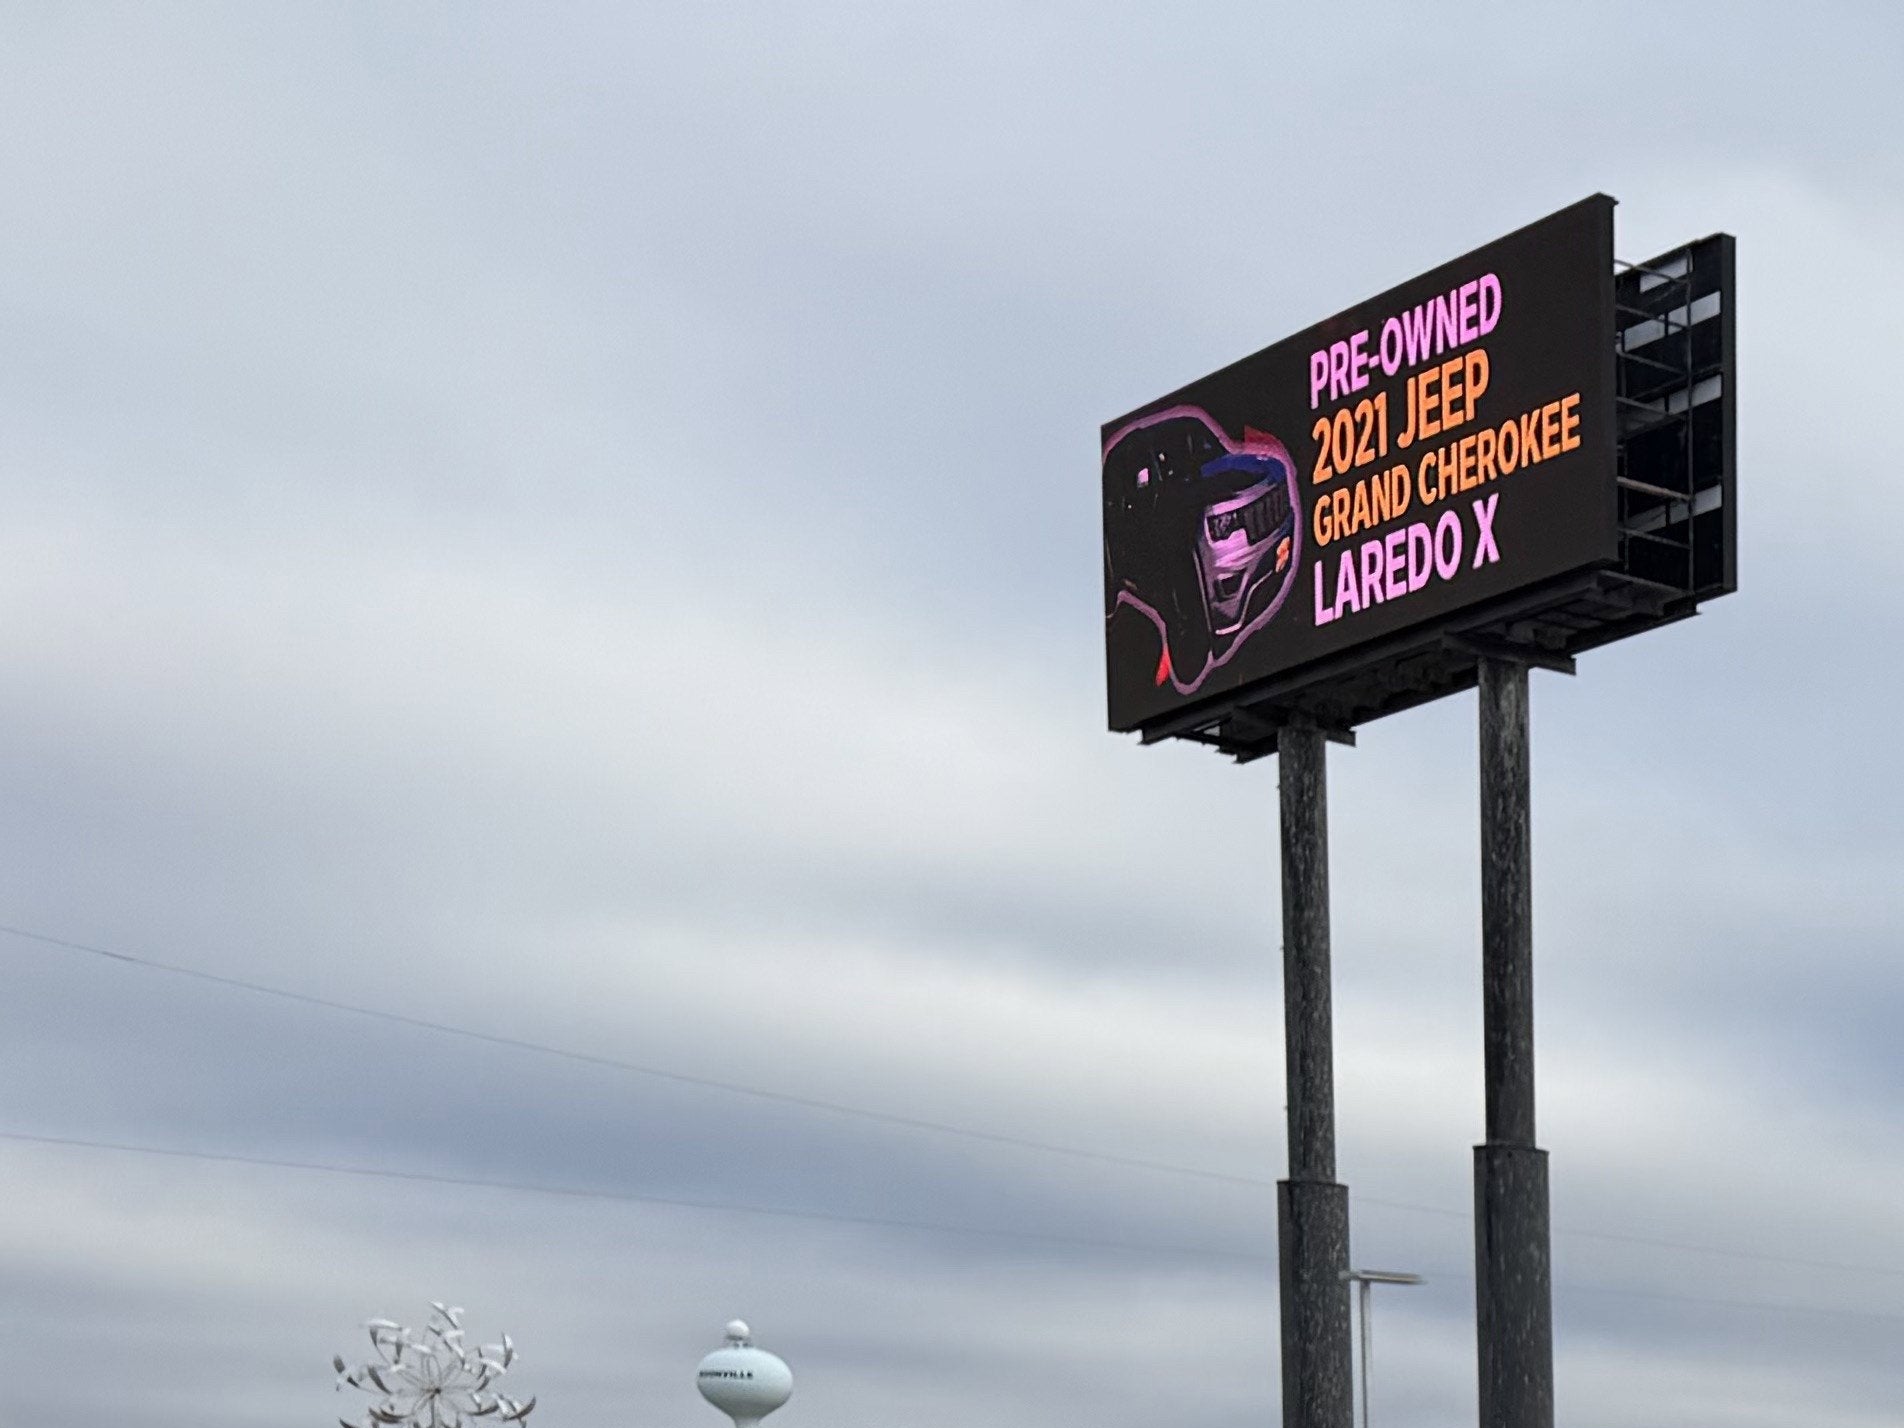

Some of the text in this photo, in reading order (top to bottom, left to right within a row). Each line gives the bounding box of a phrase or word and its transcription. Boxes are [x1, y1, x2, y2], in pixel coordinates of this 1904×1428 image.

[1310, 273, 1502, 409] PRE-OWNED
[1312, 348, 1490, 486] 2021 JEEP
[1313, 392, 1581, 548] GRAND CHEROKEE
[1314, 493, 1500, 627] LAREDO X
